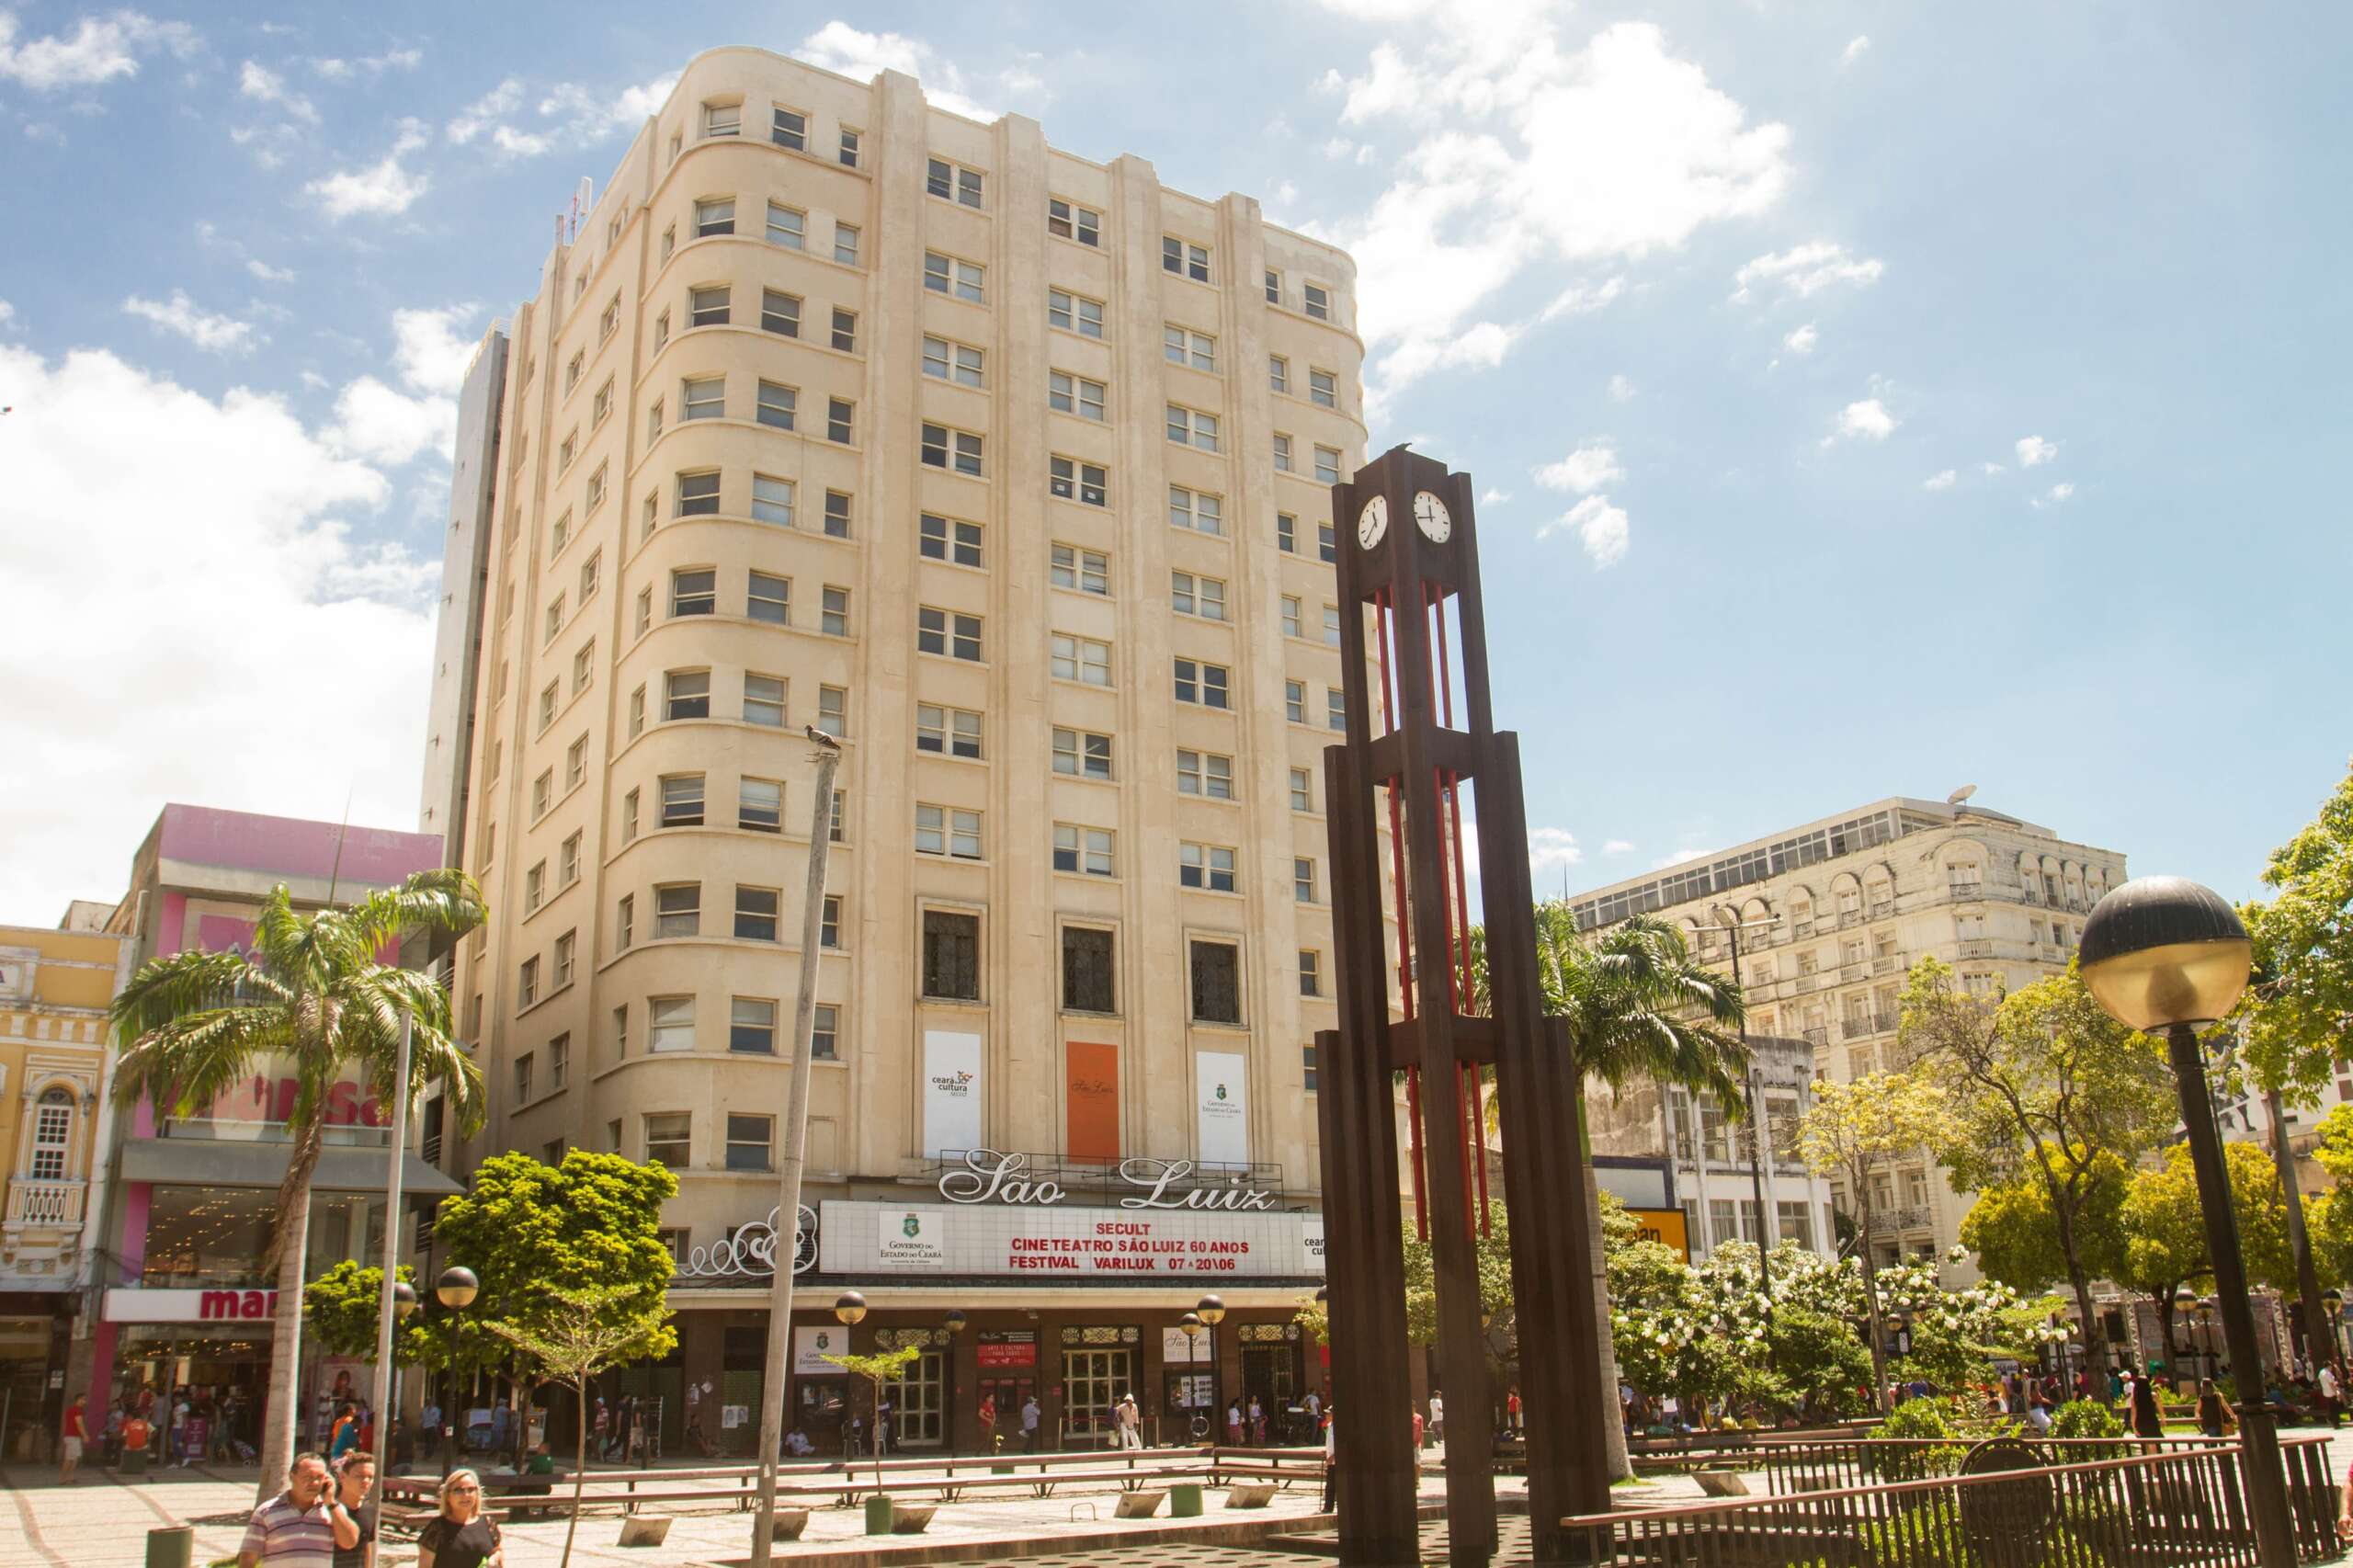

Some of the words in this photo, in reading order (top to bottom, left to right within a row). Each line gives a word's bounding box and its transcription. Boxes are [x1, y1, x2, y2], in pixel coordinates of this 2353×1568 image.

[938, 1084, 968, 1092] cultura
[938, 1148, 1065, 1204] São
[1120, 1157, 1276, 1210] Luiz
[1096, 1222, 1151, 1235] SECULT
[1012, 1238, 1049, 1251] CINE
[1051, 1240, 1113, 1252] TEATRO
[1118, 1238, 1149, 1253] SÃO
[1152, 1241, 1185, 1253] LUIZ
[1190, 1241, 1207, 1253] 60
[1210, 1242, 1249, 1254] ANOS
[1009, 1256, 1079, 1268] FESTIVAL
[1094, 1256, 1154, 1270] VARILUX
[1168, 1257, 1185, 1270] 07
